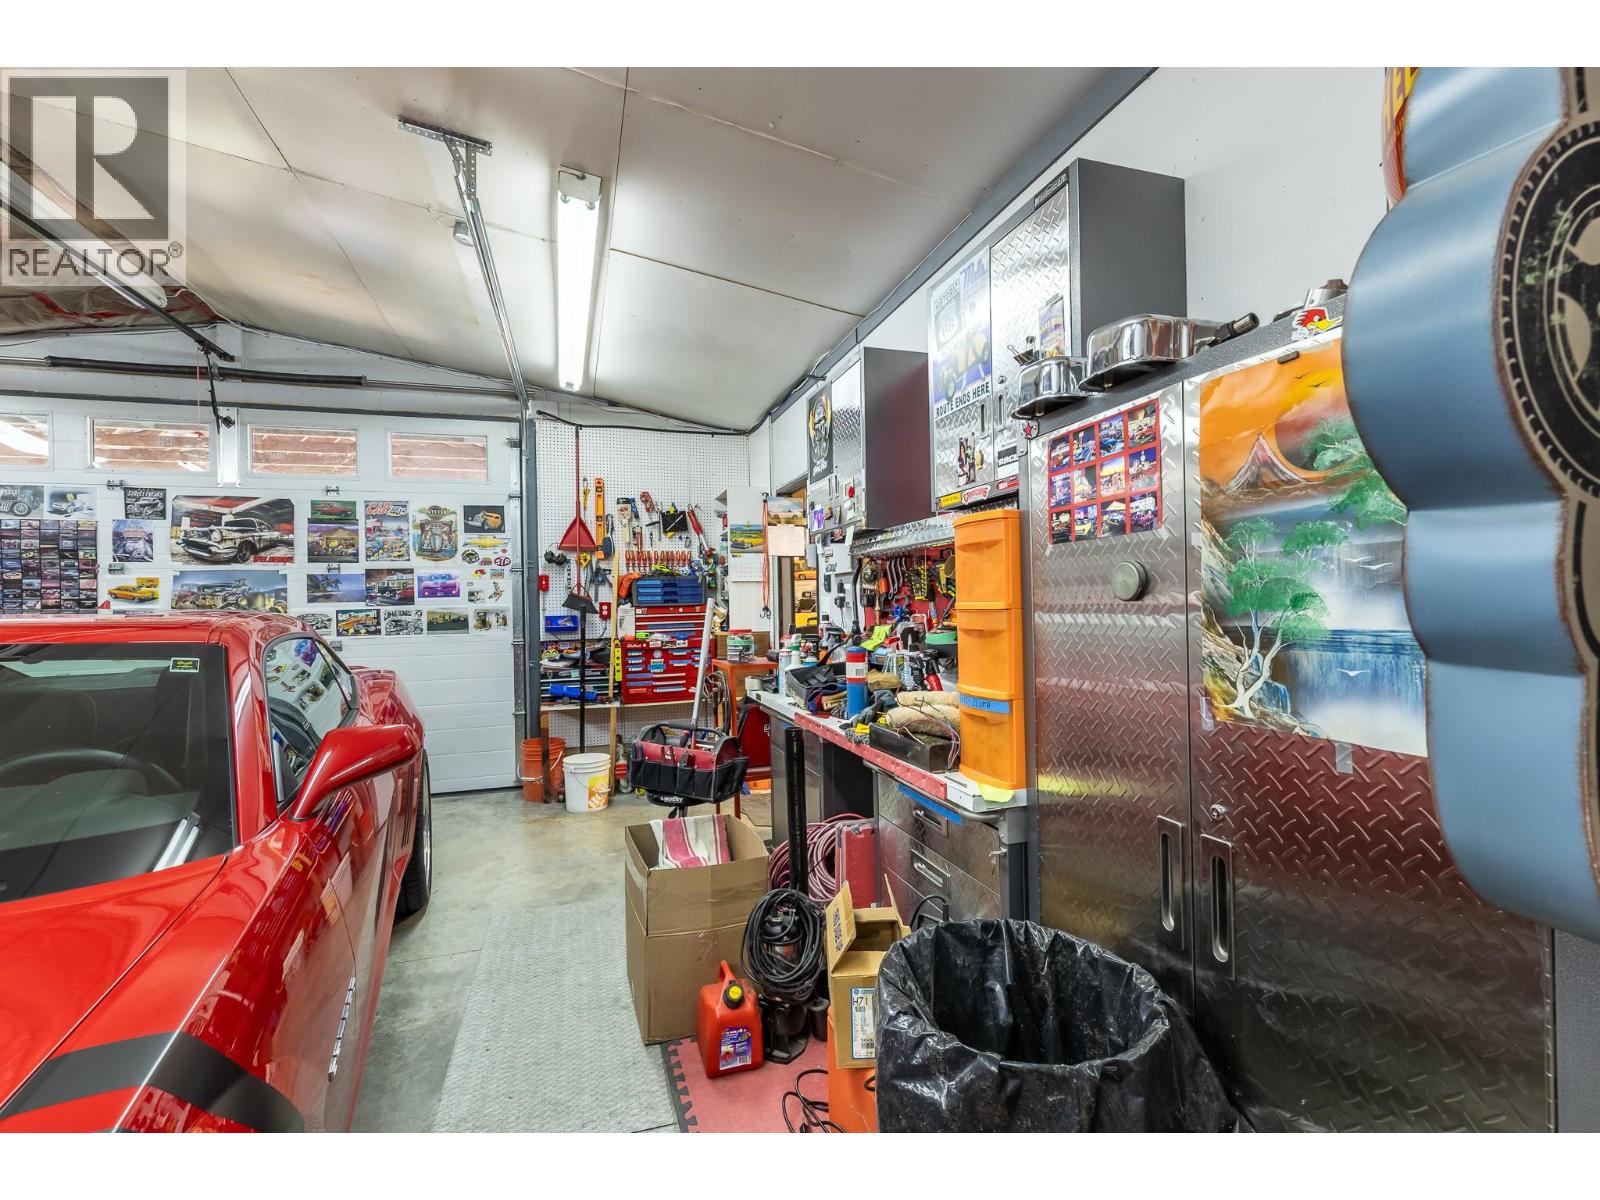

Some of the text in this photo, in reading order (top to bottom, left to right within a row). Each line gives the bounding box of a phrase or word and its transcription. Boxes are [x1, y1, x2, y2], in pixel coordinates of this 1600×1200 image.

[936, 382, 990, 417] ROUTE ENDS HERE
[495, 557, 511, 567] STP
